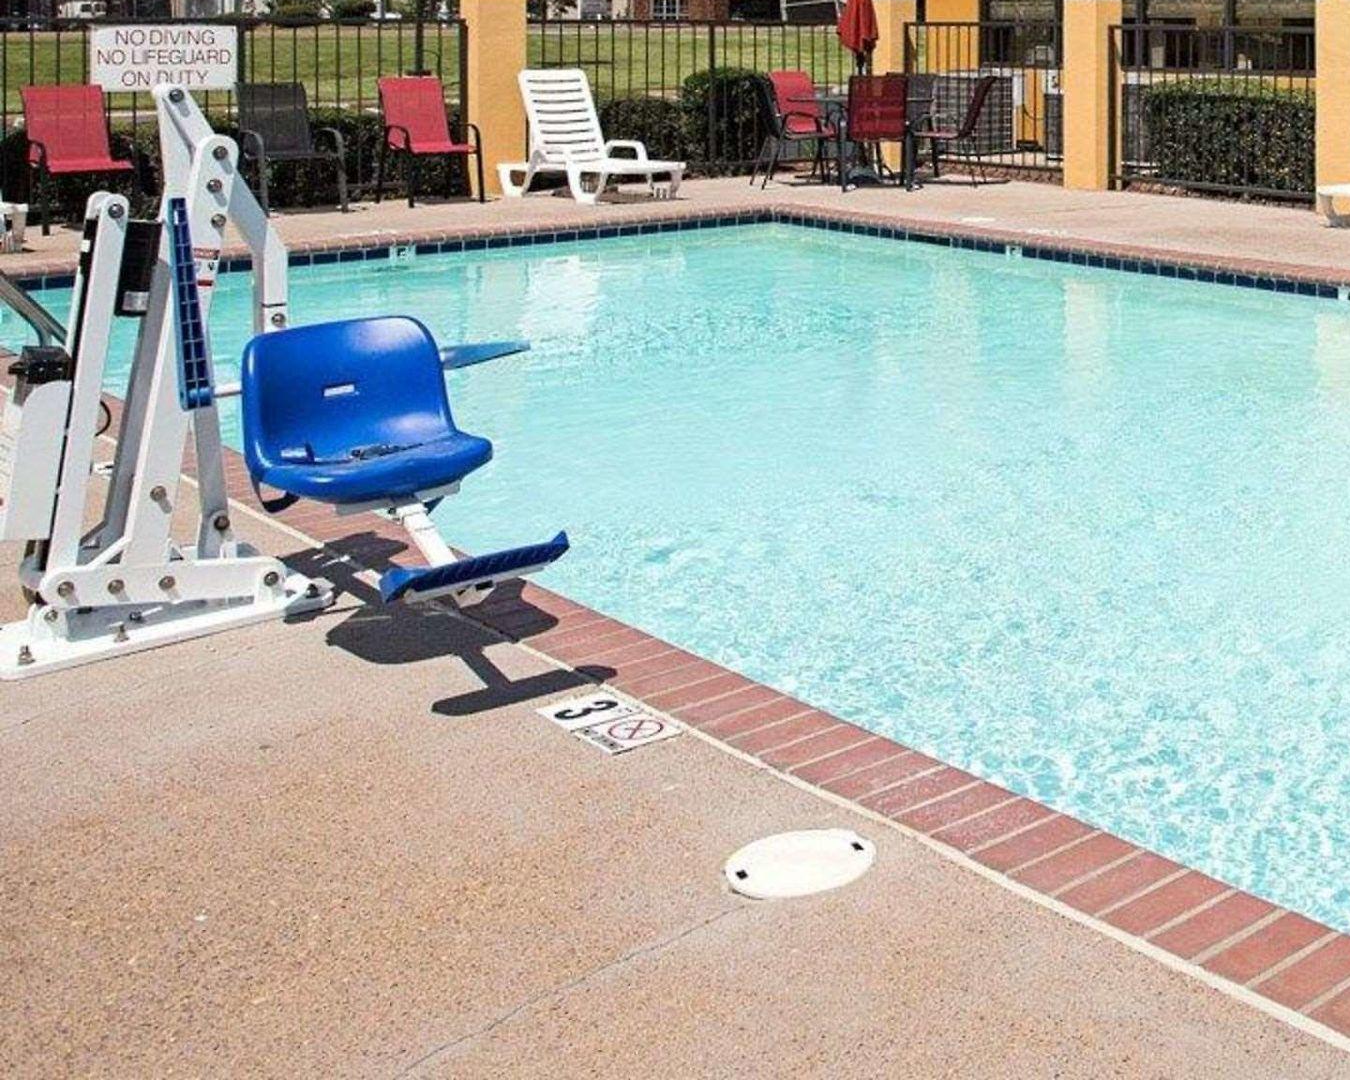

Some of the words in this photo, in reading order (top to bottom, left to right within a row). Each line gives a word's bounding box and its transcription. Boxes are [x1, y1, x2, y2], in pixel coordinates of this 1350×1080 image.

[115, 29, 146, 46] NO
[150, 29, 215, 46] DIVING
[97, 49, 126, 65] NO
[131, 49, 232, 66] LIFEGUARD
[121, 71, 151, 87] ON
[156, 71, 209, 85] DUTY
[554, 699, 619, 720] 3
